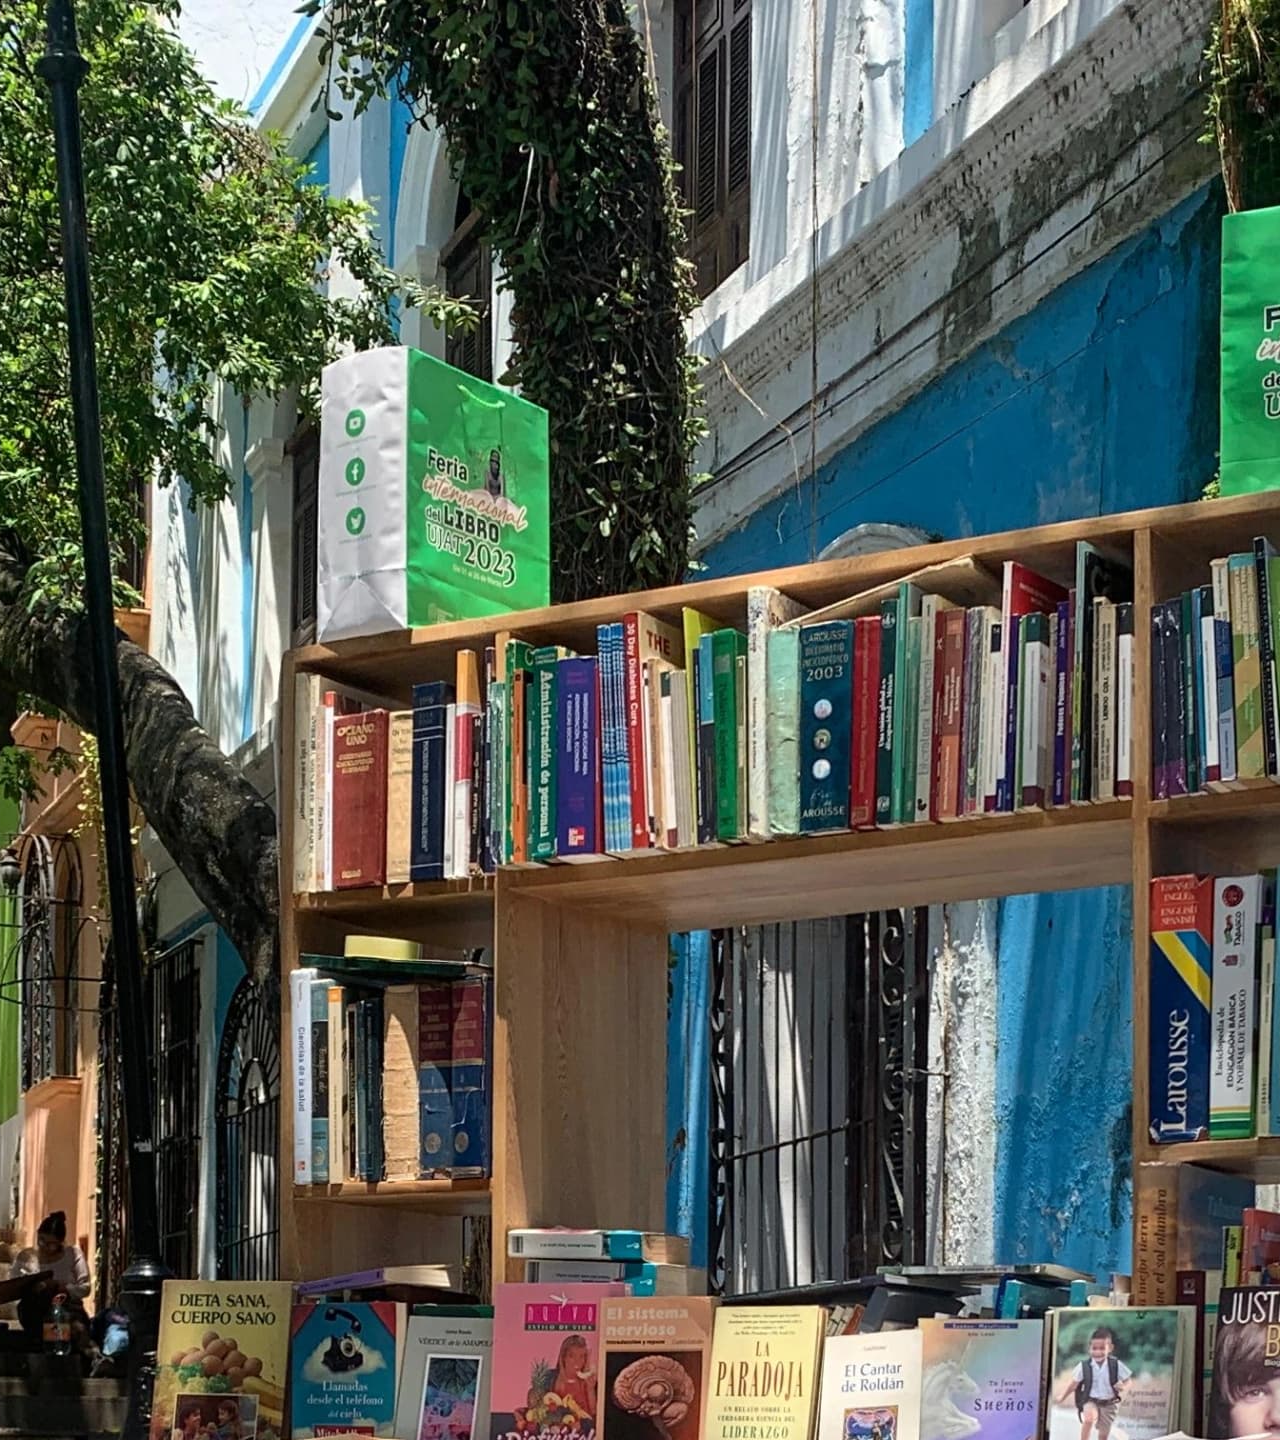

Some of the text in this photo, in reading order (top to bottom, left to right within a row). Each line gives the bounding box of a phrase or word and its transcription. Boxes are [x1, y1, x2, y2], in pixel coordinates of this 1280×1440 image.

[428, 448, 468, 483] Feria
[422, 473, 529, 531] internacional
[426, 503, 500, 544] del LIBRO
[426, 523, 463, 556] UJAT
[463, 539, 516, 587] 2023
[627, 637, 637, 656] Day
[646, 630, 671, 654] THE
[628, 658, 638, 701] Diabetes
[806, 667, 843, 682] 2003
[631, 703, 639, 726] Cure
[538, 670, 555, 837] Administración de personal
[1233, 911, 1242, 948] TABASCO
[1239, 989, 1248, 1029] TABASCO
[1214, 1006, 1226, 1077] Enciclopedia de
[1226, 994, 1237, 1088] EDUCACIÓN BÁSICA
[1238, 1032, 1246, 1043] DE
[297, 1026, 306, 1113] Ciencias de la salud
[1160, 1008, 1190, 1133] Larousse
[1237, 1047, 1246, 1084] NORMAL
[1154, 1188, 1168, 1284] el sol alumbra
[1139, 1215, 1148, 1294] mejor tierra
[179, 1293, 270, 1309] DIETA SANA,
[171, 1310, 276, 1326] CUERPO SANO
[607, 1307, 689, 1320] El sistema
[606, 1322, 677, 1337] nervioso
[755, 1341, 770, 1357] LA
[716, 1361, 803, 1401] PARADOJA
[845, 1362, 903, 1378] El Cantar
[322, 1380, 368, 1392] Llamadas
[841, 1379, 904, 1393] de Roldán
[306, 1393, 384, 1405] desde el teléfono
[973, 1397, 1034, 1412] Sueños
[339, 1408, 362, 1418] cielo
[722, 1425, 789, 1439] LIDERAZGO
